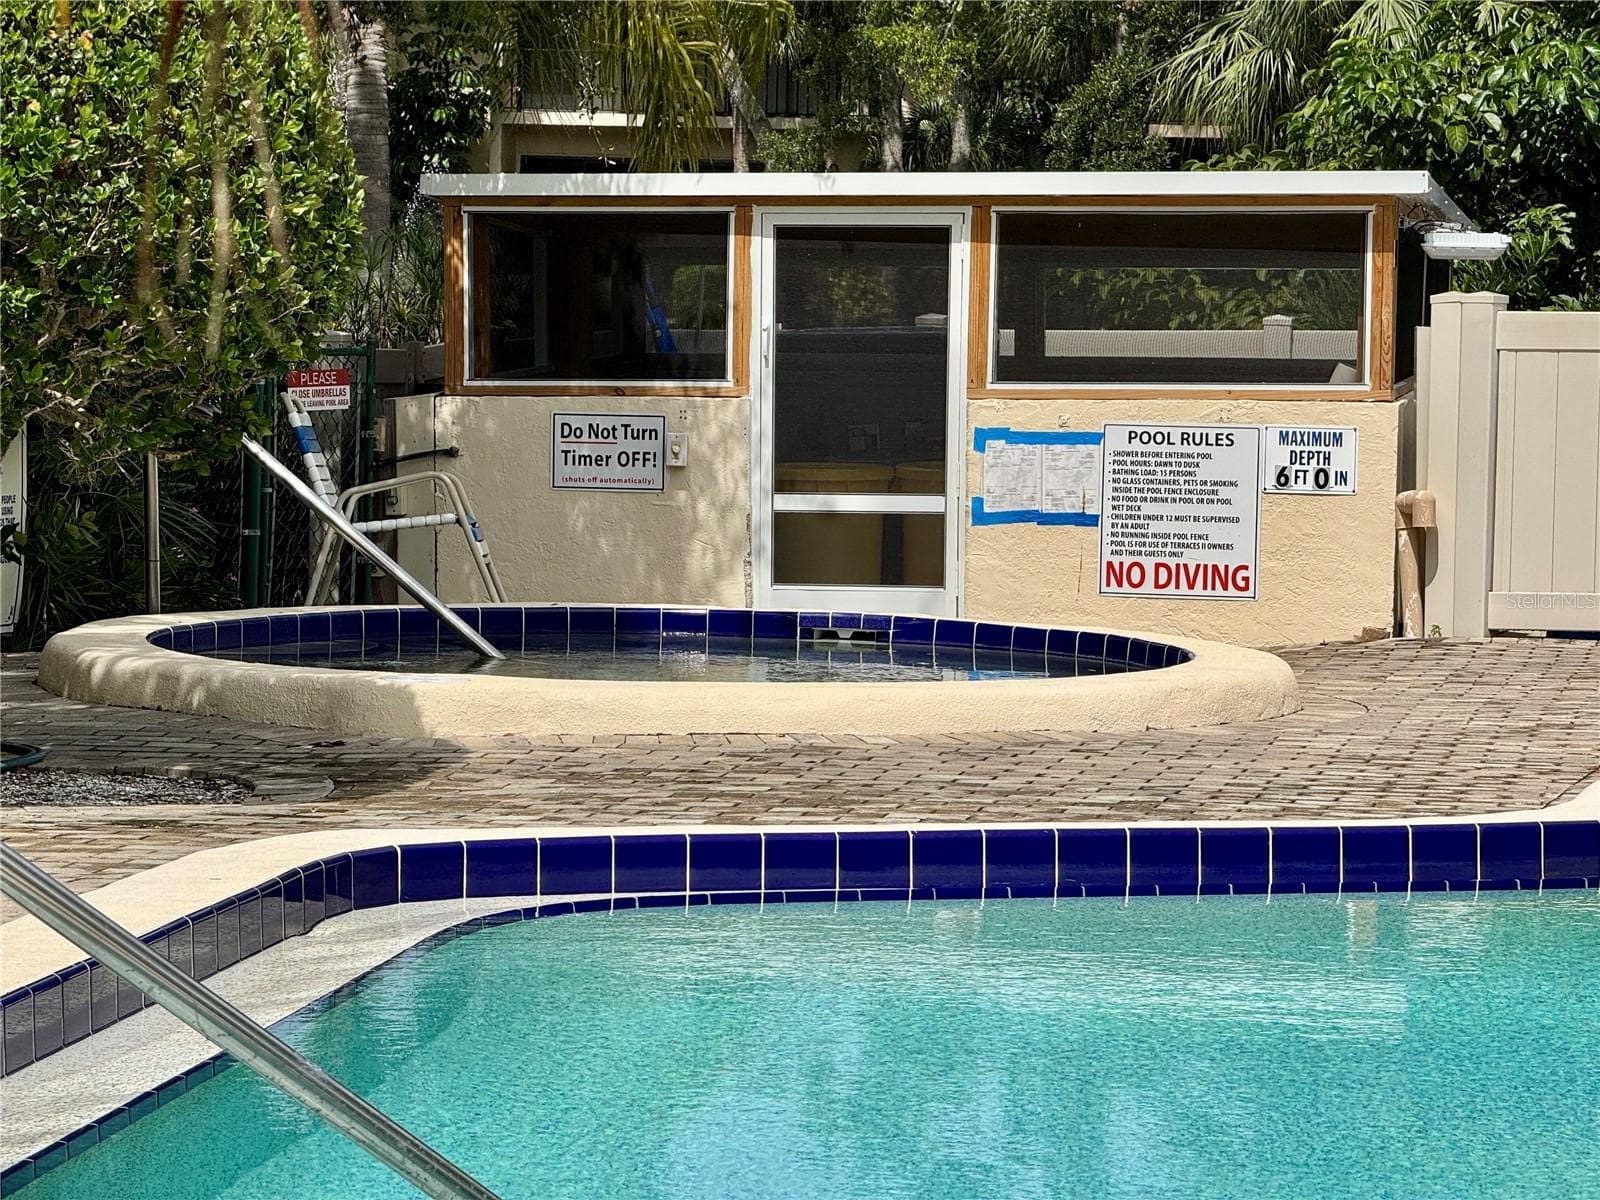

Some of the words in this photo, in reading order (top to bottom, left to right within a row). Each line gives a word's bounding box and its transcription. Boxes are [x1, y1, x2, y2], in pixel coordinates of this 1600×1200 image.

[300, 371, 337, 385] PLEASE
[311, 388, 347, 398] UMBRELLAS
[560, 422, 584, 439] Do
[588, 423, 618, 440] Not
[621, 424, 658, 440] Turn
[1128, 430, 1176, 446] POOL
[1180, 432, 1235, 447] RULES
[1279, 430, 1343, 448] MAXIMUM
[560, 450, 612, 467] Timer
[617, 451, 657, 468] OFF!
[1112, 450, 1139, 458] SHOWER
[1140, 450, 1164, 458] BEFORE
[1165, 452, 1196, 460] ENTERING
[1290, 450, 1331, 466] DEPTH
[561, 476, 585, 484] (shuts
[600, 477, 655, 486] automatically)
[1142, 478, 1182, 487] CONTAINERS,
[1276, 466, 1290, 488] 6
[1294, 470, 1309, 485] FT
[1314, 468, 1330, 490] 0
[1335, 470, 1348, 486] IN
[1202, 516, 1240, 524] SUPERVISED
[1170, 542, 1200, 550] TERRACES
[1207, 542, 1234, 550] OWNERS
[1105, 560, 1146, 589] NO
[1154, 562, 1250, 592] DIVING
